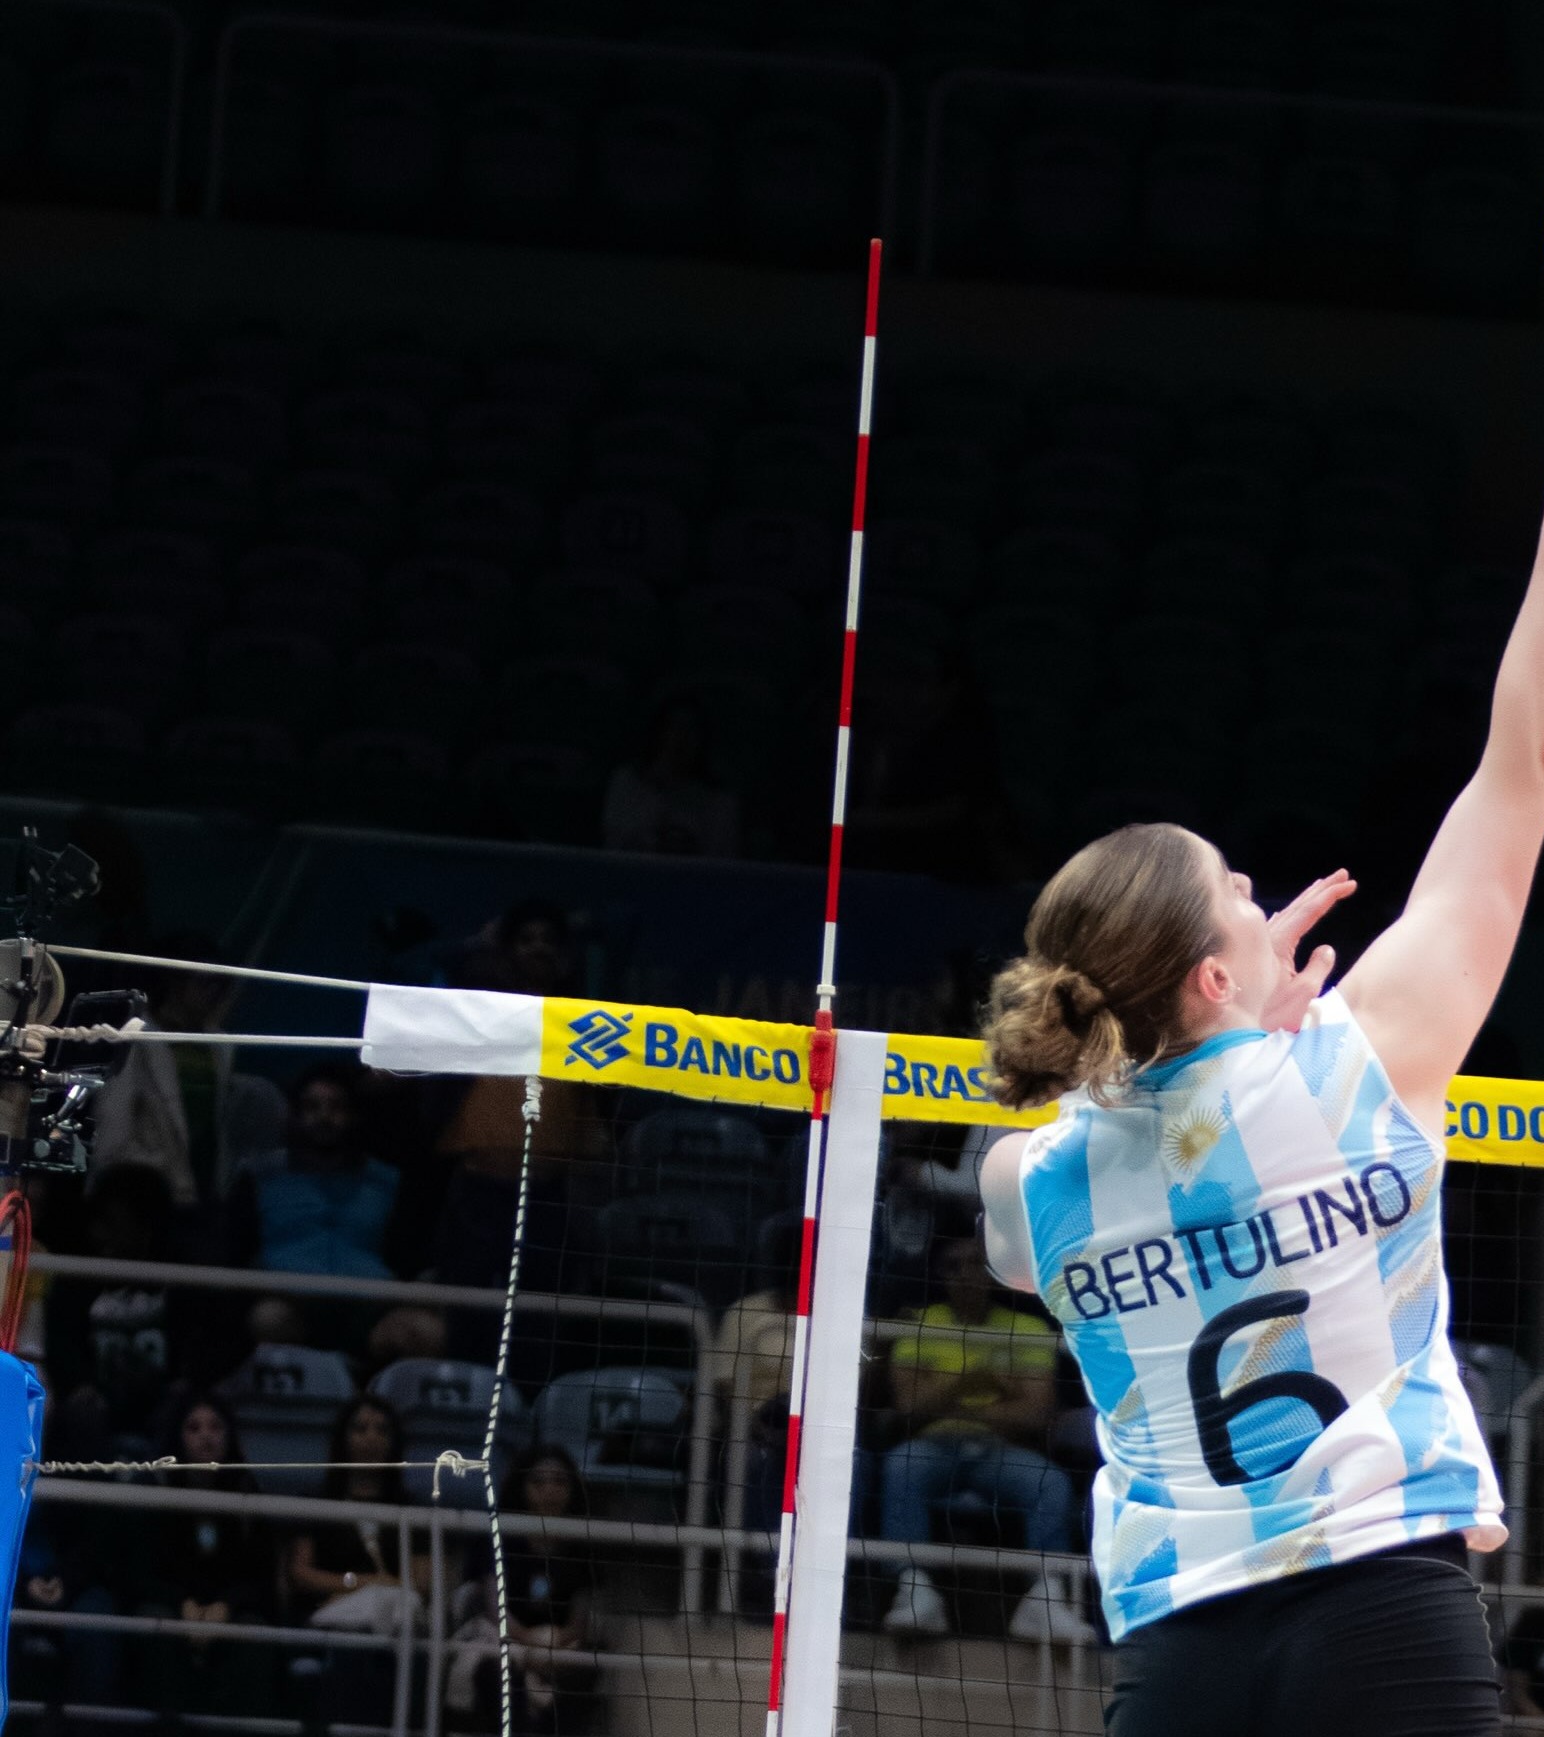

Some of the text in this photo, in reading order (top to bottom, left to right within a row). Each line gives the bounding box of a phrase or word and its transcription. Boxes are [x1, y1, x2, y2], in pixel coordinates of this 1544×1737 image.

[644, 1022, 994, 1102] BANCO BRAS
[1064, 1162, 1412, 1320] BERTULINO
[1187, 1289, 1350, 1487] 6
